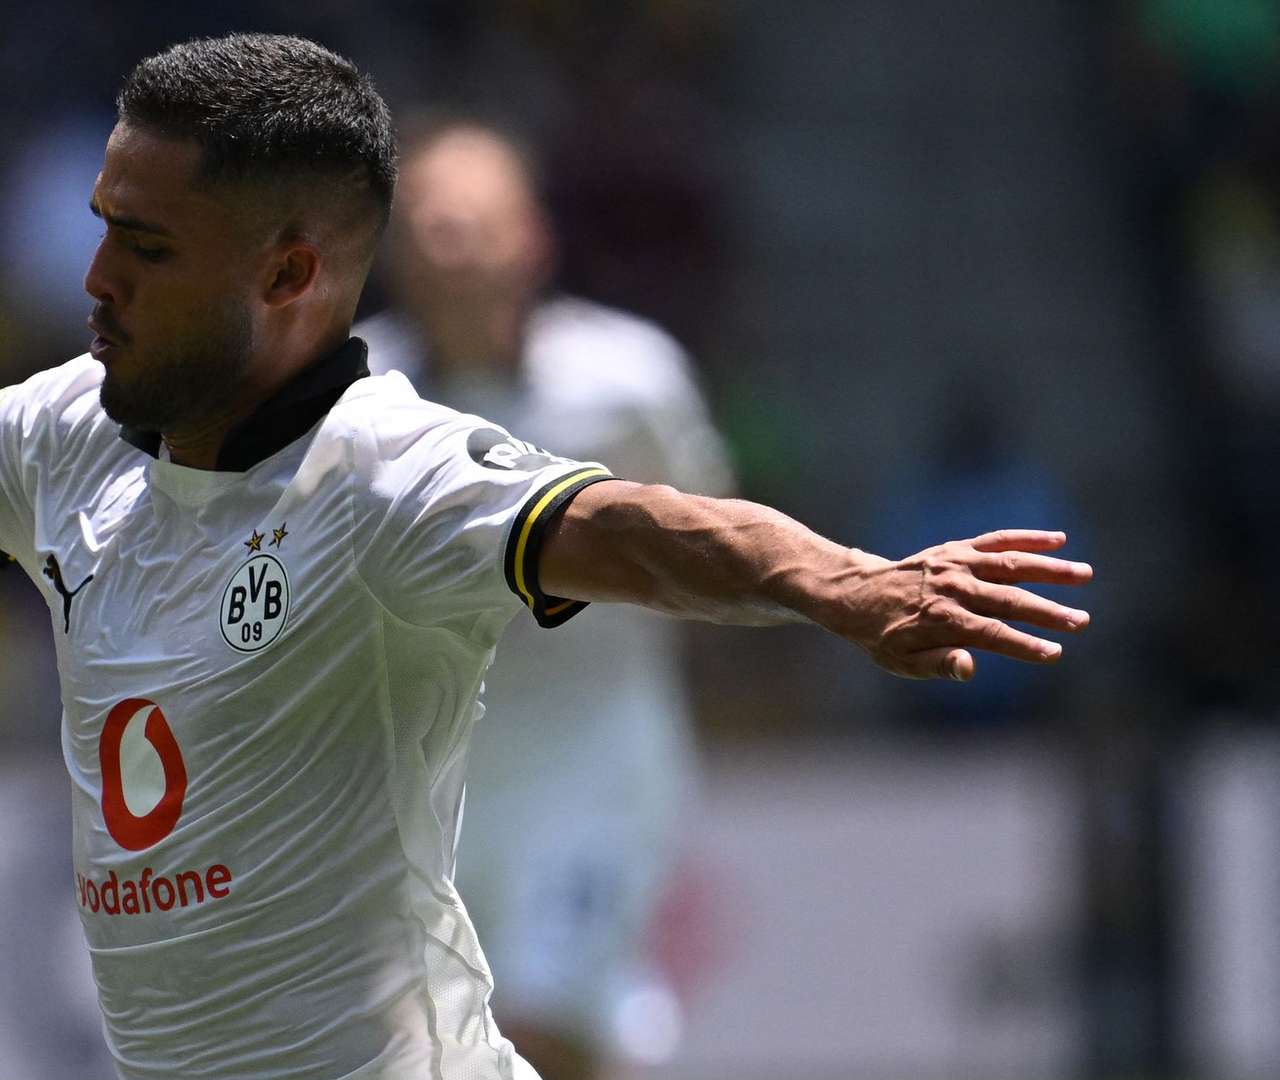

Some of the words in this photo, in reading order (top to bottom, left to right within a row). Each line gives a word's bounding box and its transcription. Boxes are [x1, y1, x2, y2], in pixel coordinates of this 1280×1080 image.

[227, 563, 282, 625] BVB
[242, 621, 262, 643] 09
[77, 864, 233, 916] vodafone
